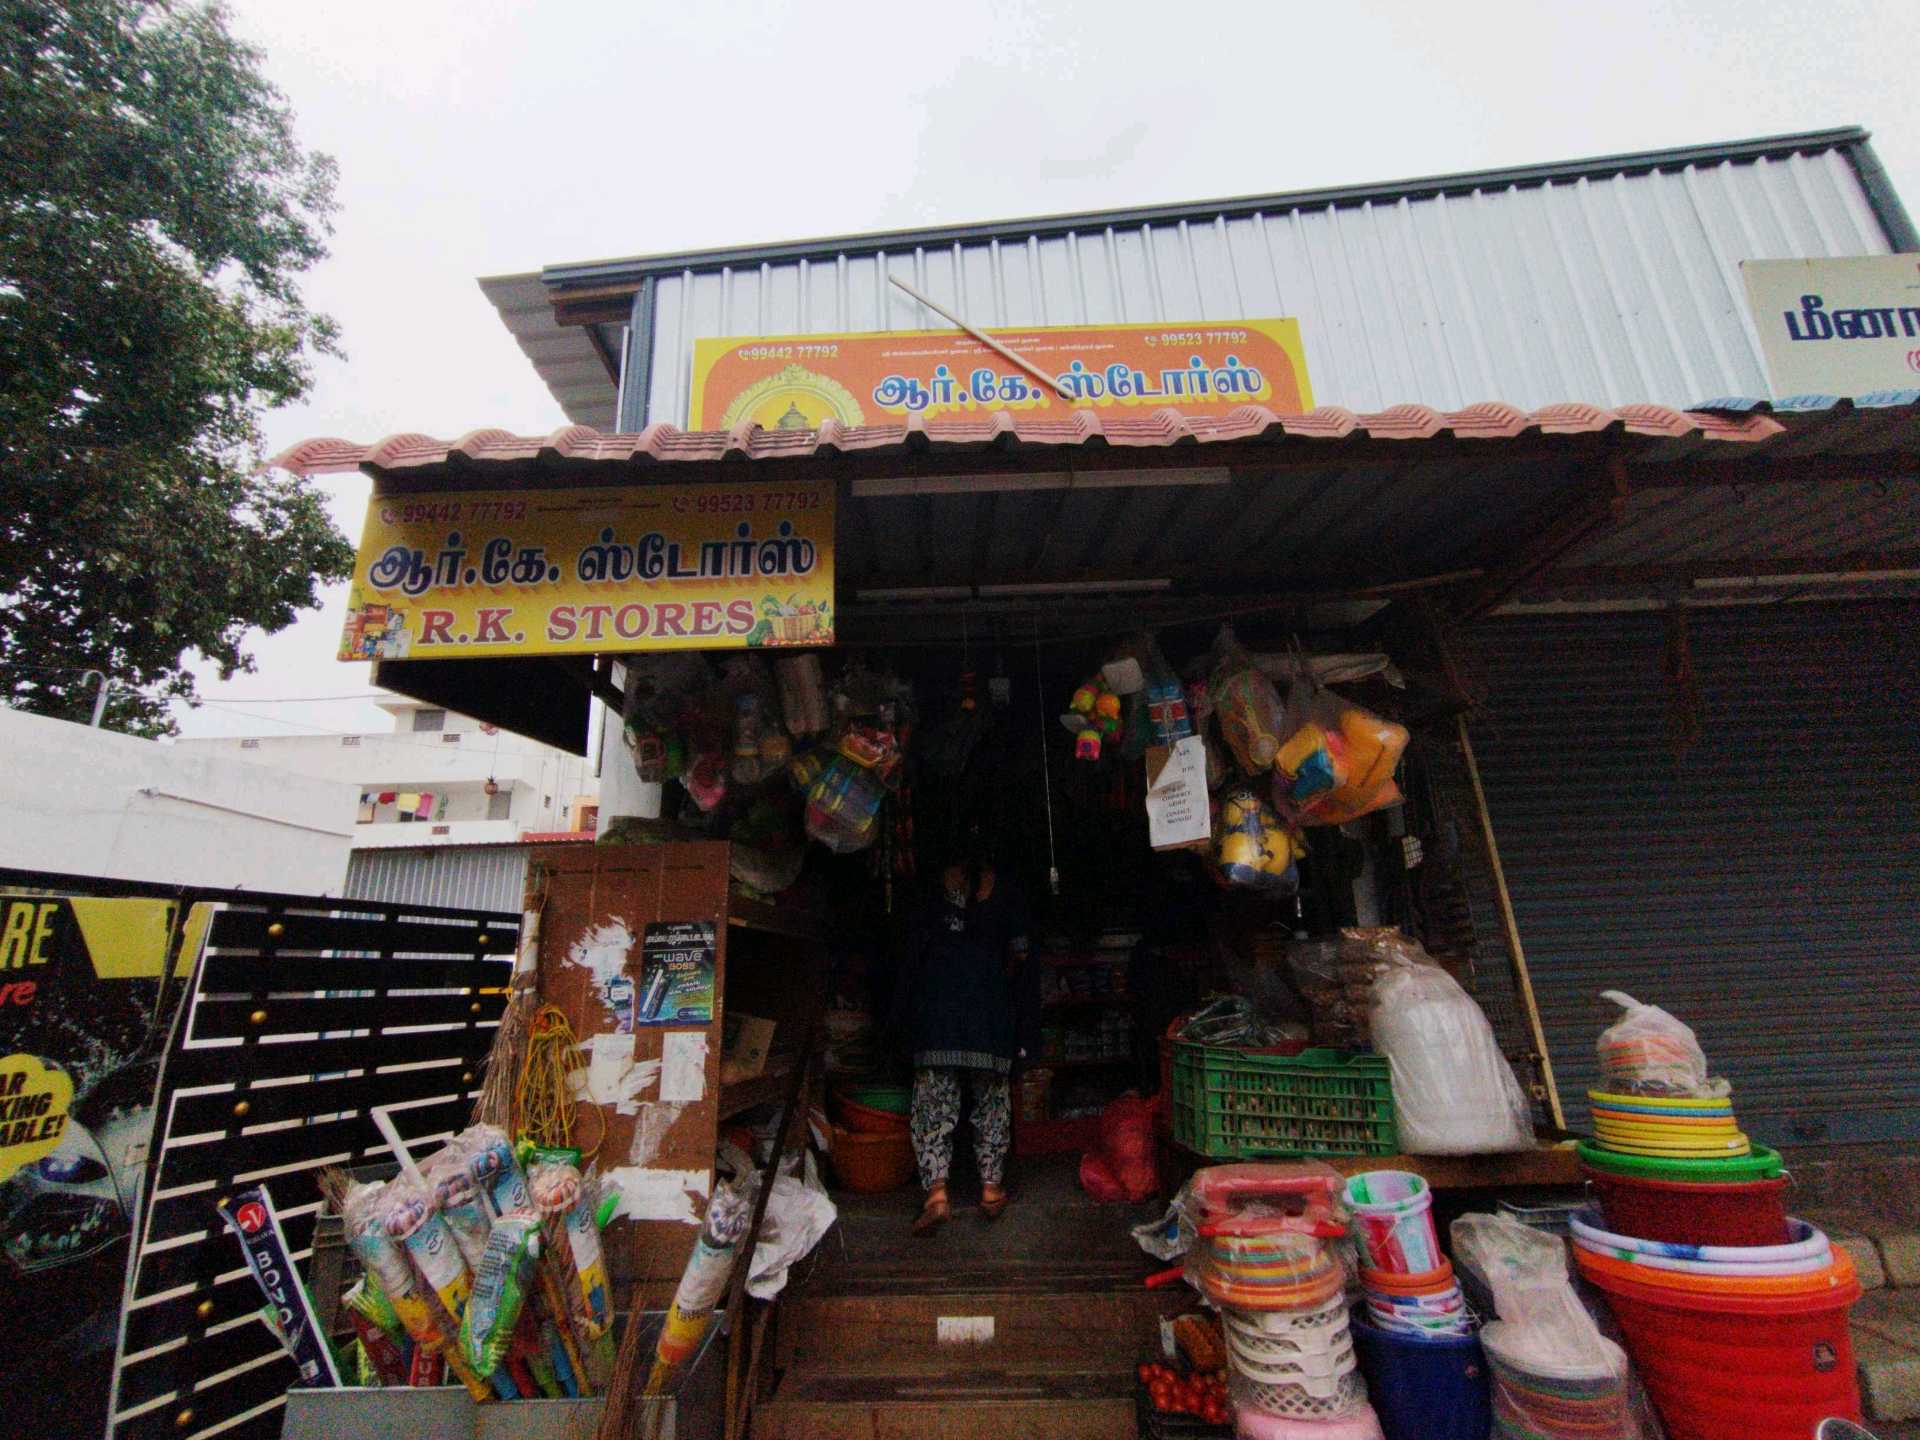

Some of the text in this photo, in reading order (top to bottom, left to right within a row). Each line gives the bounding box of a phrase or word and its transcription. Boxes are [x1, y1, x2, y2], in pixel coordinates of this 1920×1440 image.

[1161, 331, 1248, 347] 99523 77792
[751, 344, 839, 360] 99442 77792
[403, 503, 462, 522] 99442
[469, 501, 527, 520] 77792
[697, 491, 820, 513] 99523 77792
[577, 520, 815, 582] ஸ்டோர்ஸ்
[418, 599, 757, 645] R.K. STORES
